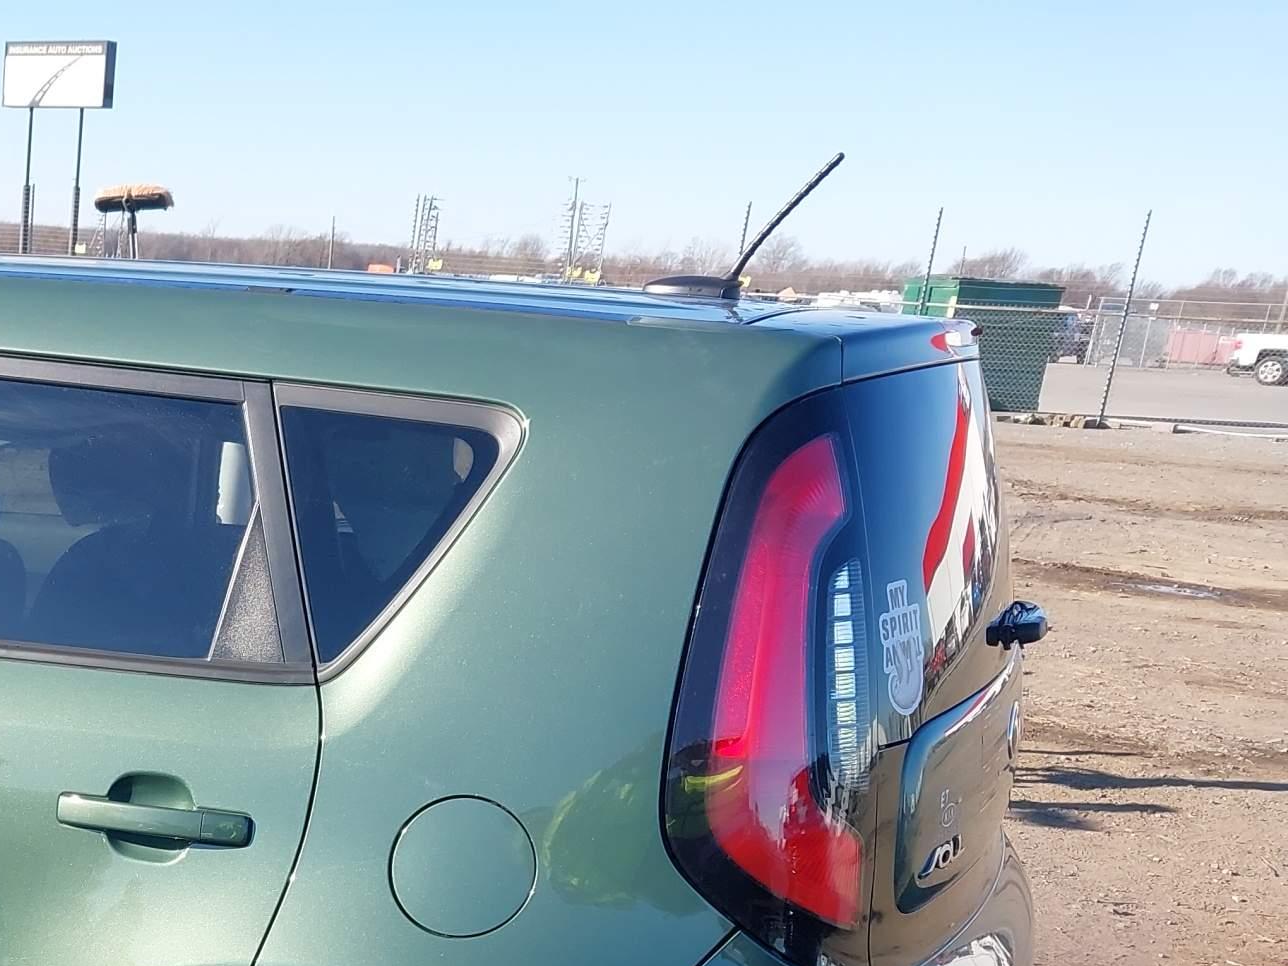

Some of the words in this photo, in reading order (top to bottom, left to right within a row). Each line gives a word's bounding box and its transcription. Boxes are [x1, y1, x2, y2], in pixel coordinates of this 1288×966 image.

[47, 45, 67, 54] AUTO
[67, 44, 103, 54] AUCTIONS
[889, 585, 905, 610] MY
[881, 609, 919, 641] SPIRIT
